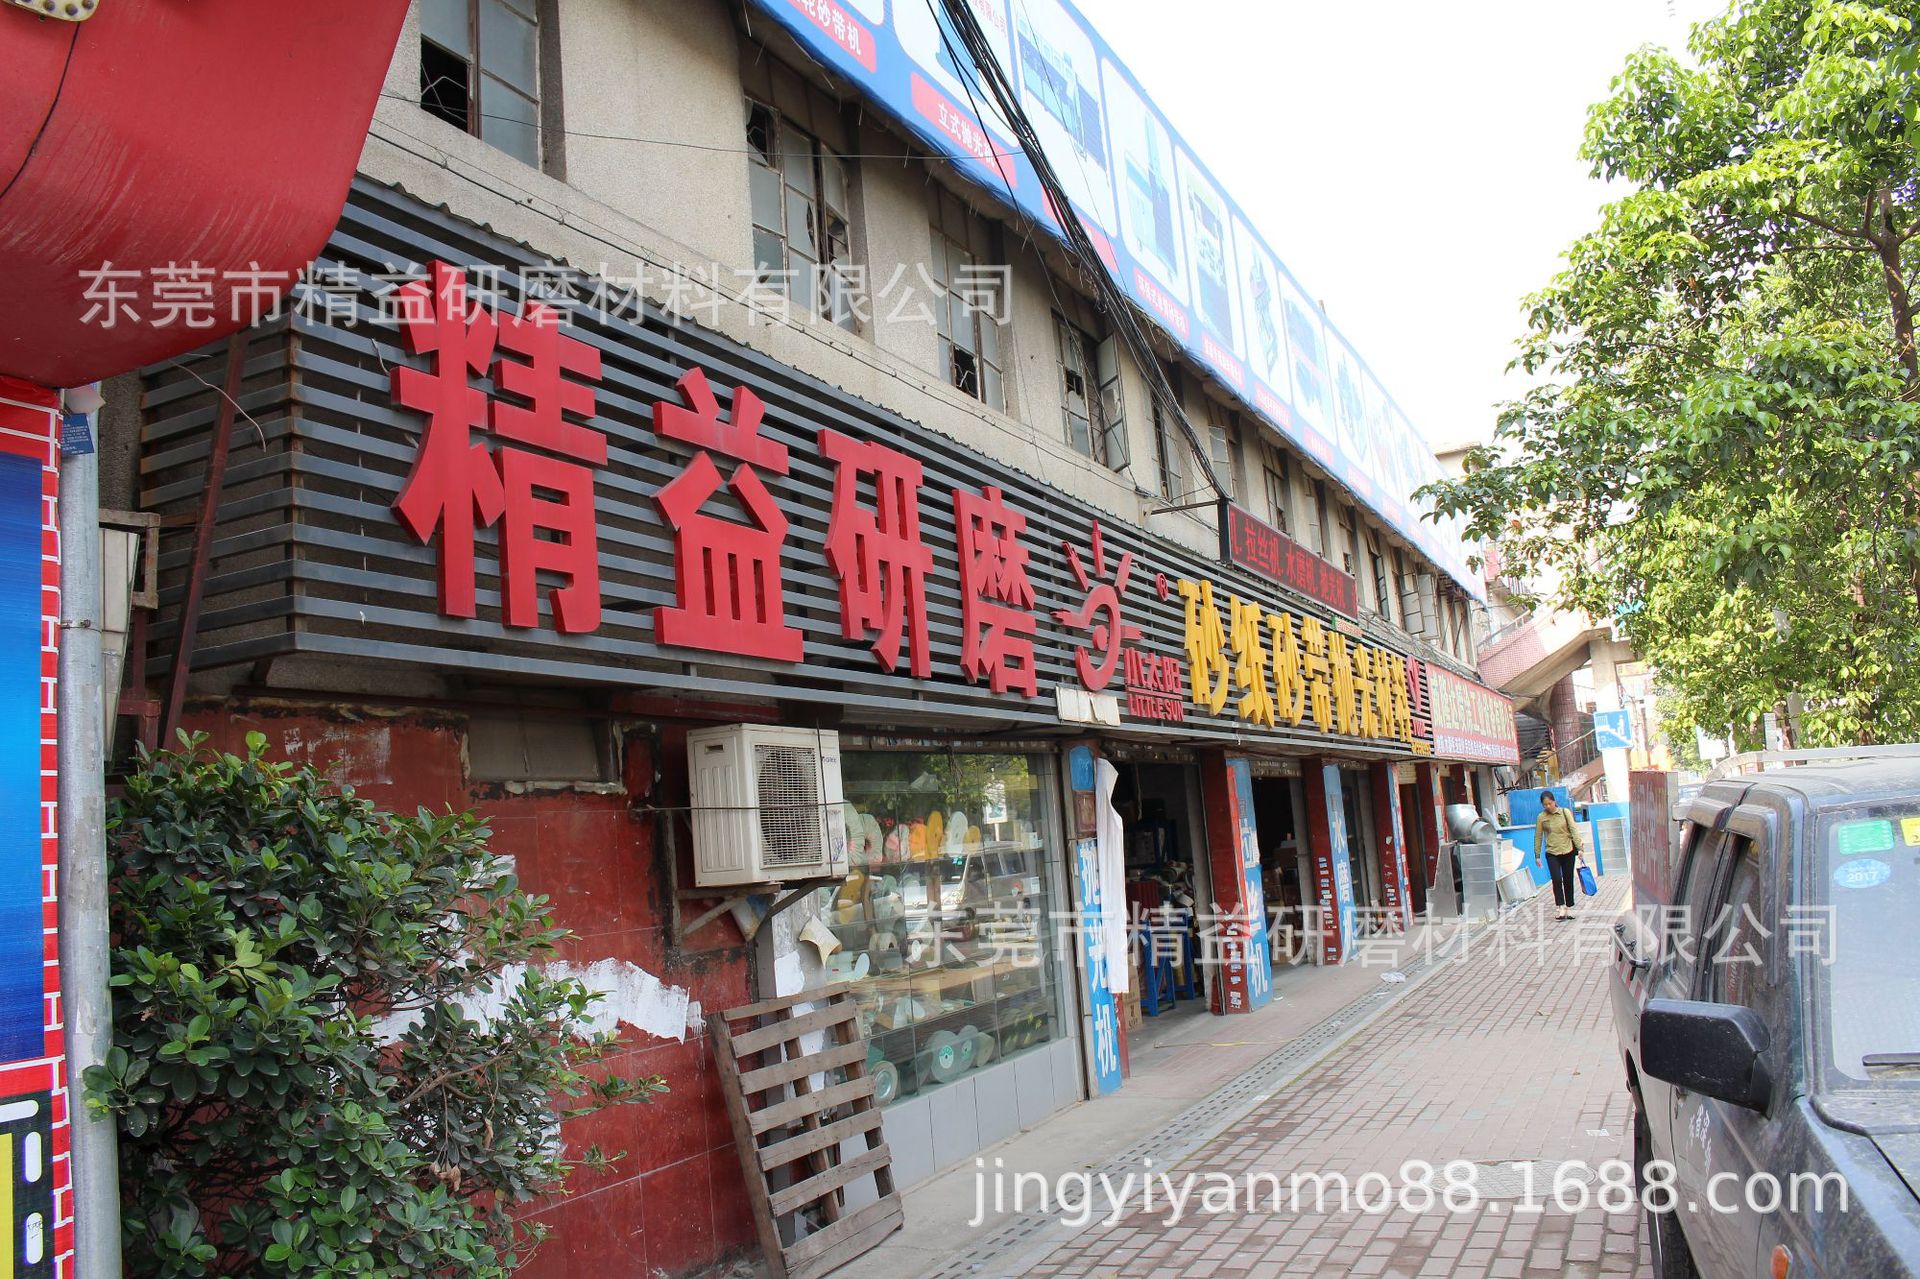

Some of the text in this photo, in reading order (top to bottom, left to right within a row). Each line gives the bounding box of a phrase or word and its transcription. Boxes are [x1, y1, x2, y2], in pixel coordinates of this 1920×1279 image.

[391, 259, 1037, 699] 精益研磨
[1123, 646, 1182, 694] 小太阳
[1177, 578, 1412, 743] 砂纸砂带抛光材料
[1127, 694, 1184, 722] LITTLE SUN
[1847, 871, 1879, 882] 2017
